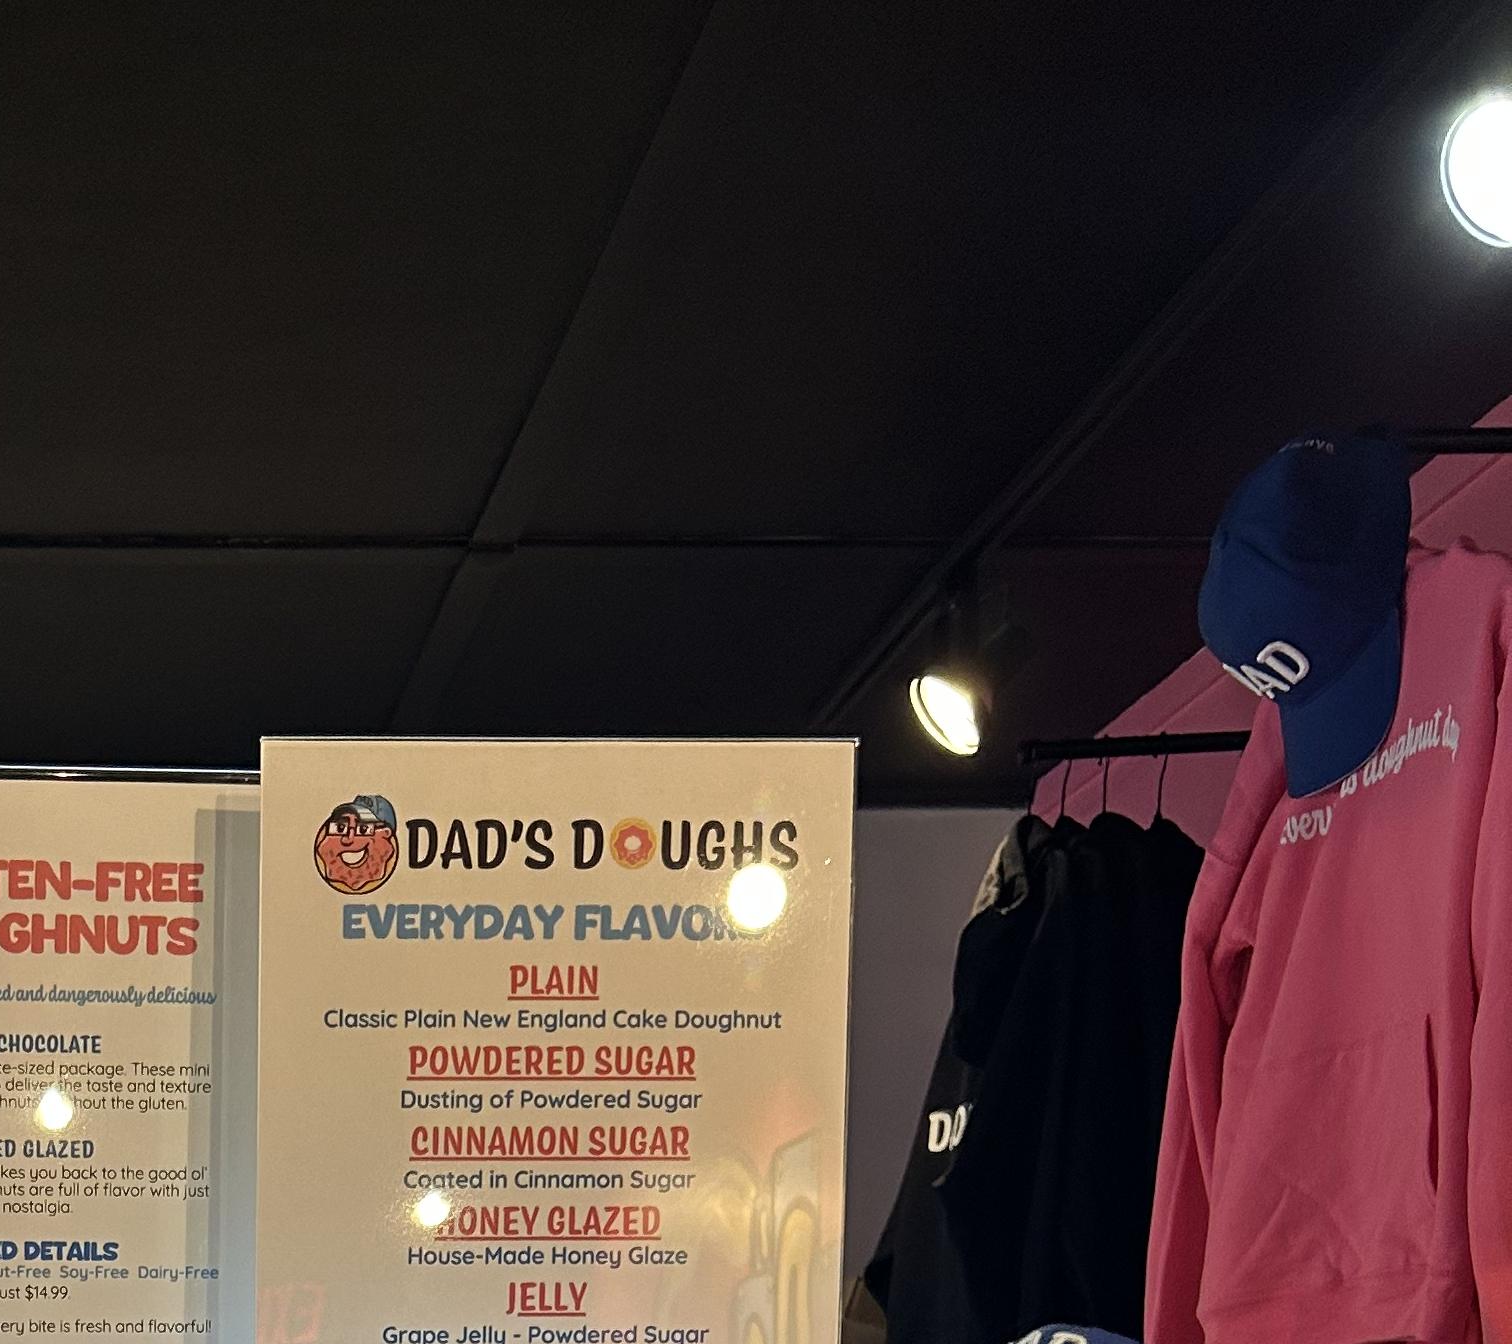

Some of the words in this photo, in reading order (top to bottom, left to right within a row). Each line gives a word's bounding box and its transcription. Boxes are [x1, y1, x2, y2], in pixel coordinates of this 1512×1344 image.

[1222, 641, 1310, 699] AD
[406, 819, 554, 869] DAD'S
[343, 904, 564, 940] EVERYDAY
[510, 965, 598, 995] PLAIN
[324, 1009, 397, 1028] Classic
[405, 1009, 455, 1028] Plain
[464, 1010, 511, 1028] New
[518, 1009, 606, 1032] England
[613, 1009, 667, 1028] Cake
[675, 1010, 781, 1033] Doughnut
[409, 1046, 584, 1075] POWDERED
[595, 1046, 695, 1075] SUGAR
[401, 1090, 482, 1113] Dusting
[490, 1090, 514, 1108] of
[521, 1090, 630, 1109] Powdered
[638, 1090, 702, 1113] Sugar
[23, 1140, 94, 1158] GLAZED
[412, 1126, 578, 1156] CINNAMON
[589, 1126, 689, 1156] SUGAR
[548, 1206, 659, 1235] GLAZED
[24, 1241, 119, 1261] DETAILS
[408, 1246, 544, 1265] House-Made
[552, 1247, 621, 1269] Honey
[629, 1246, 688, 1264] Glaze
[60, 1266, 129, 1281] Soy-Free
[138, 1266, 219, 1283] Dairy-Free
[506, 1282, 587, 1315] JELLY
